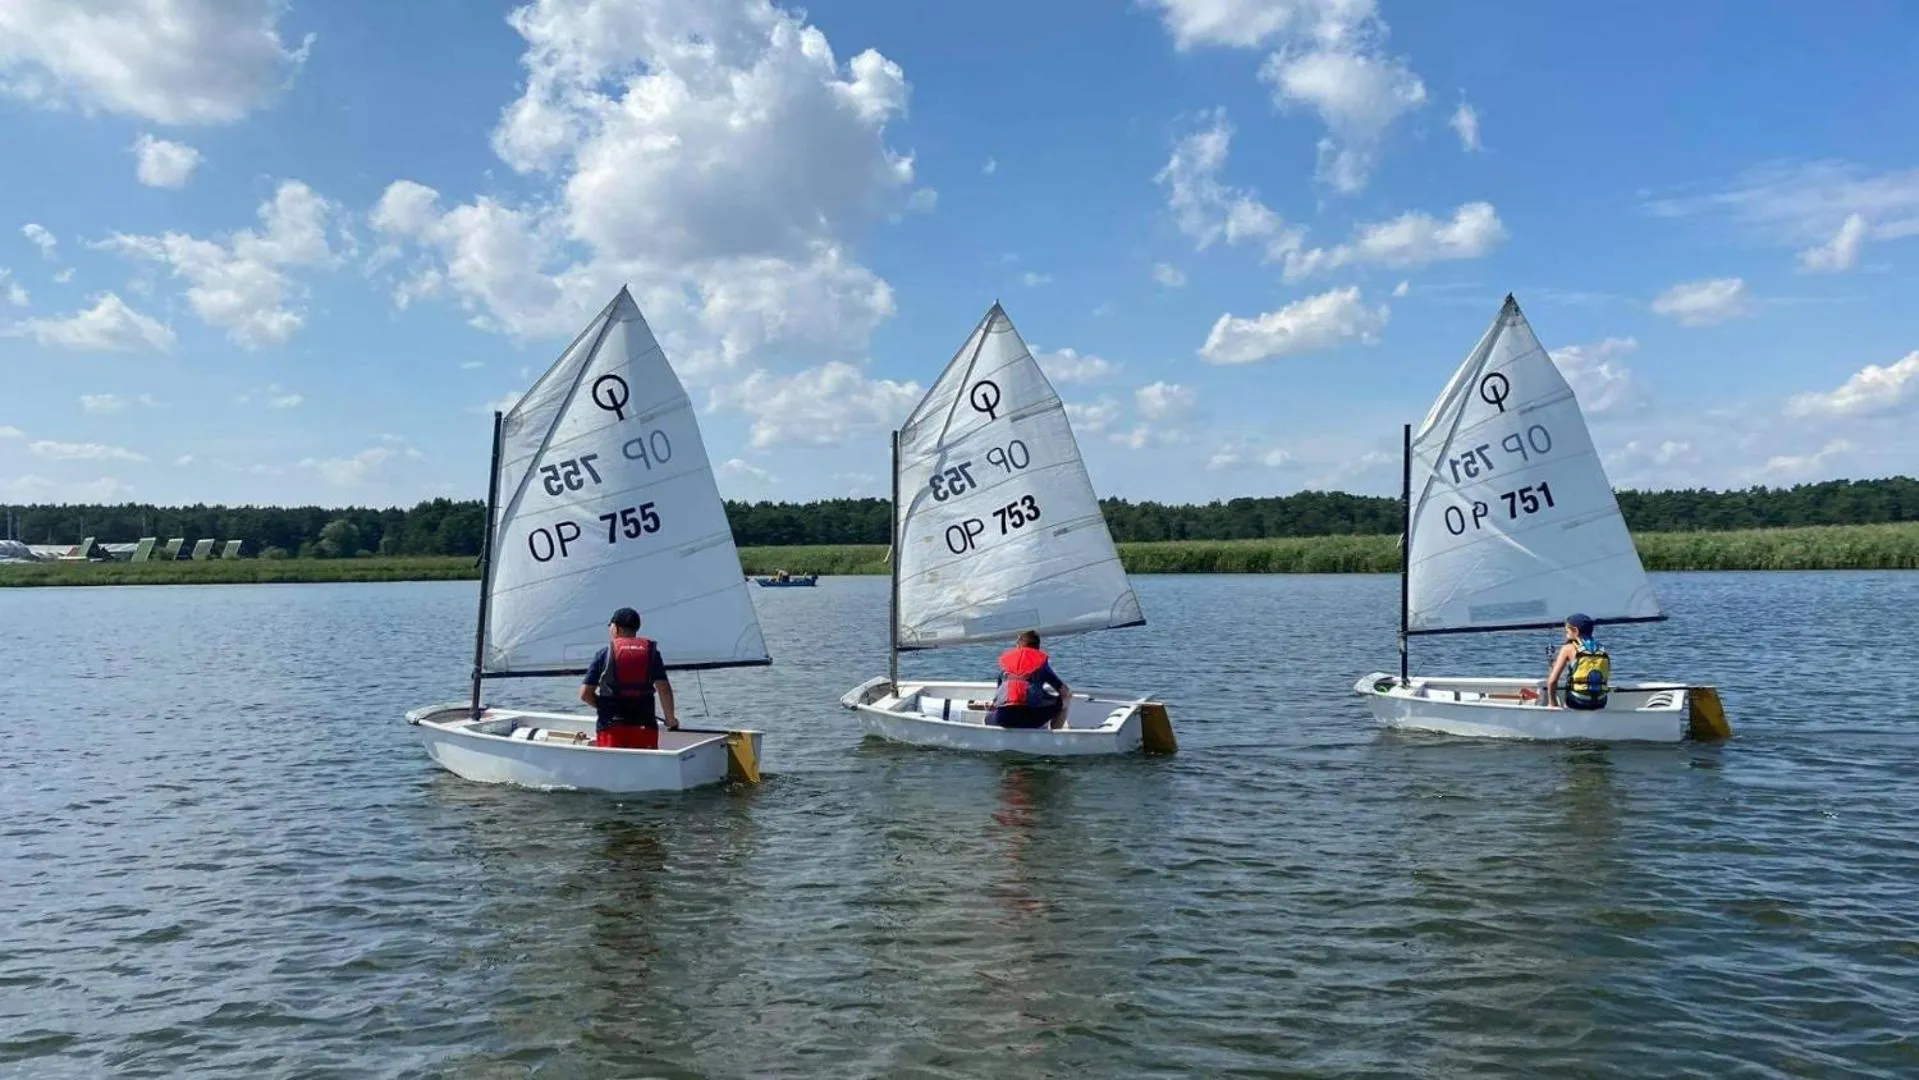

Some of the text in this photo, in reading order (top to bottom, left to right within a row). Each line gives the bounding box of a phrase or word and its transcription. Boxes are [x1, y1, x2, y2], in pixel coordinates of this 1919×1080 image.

[528, 502, 661, 563] OP 755
[945, 495, 1041, 555] OP 753
[1445, 481, 1555, 536] OP 751
